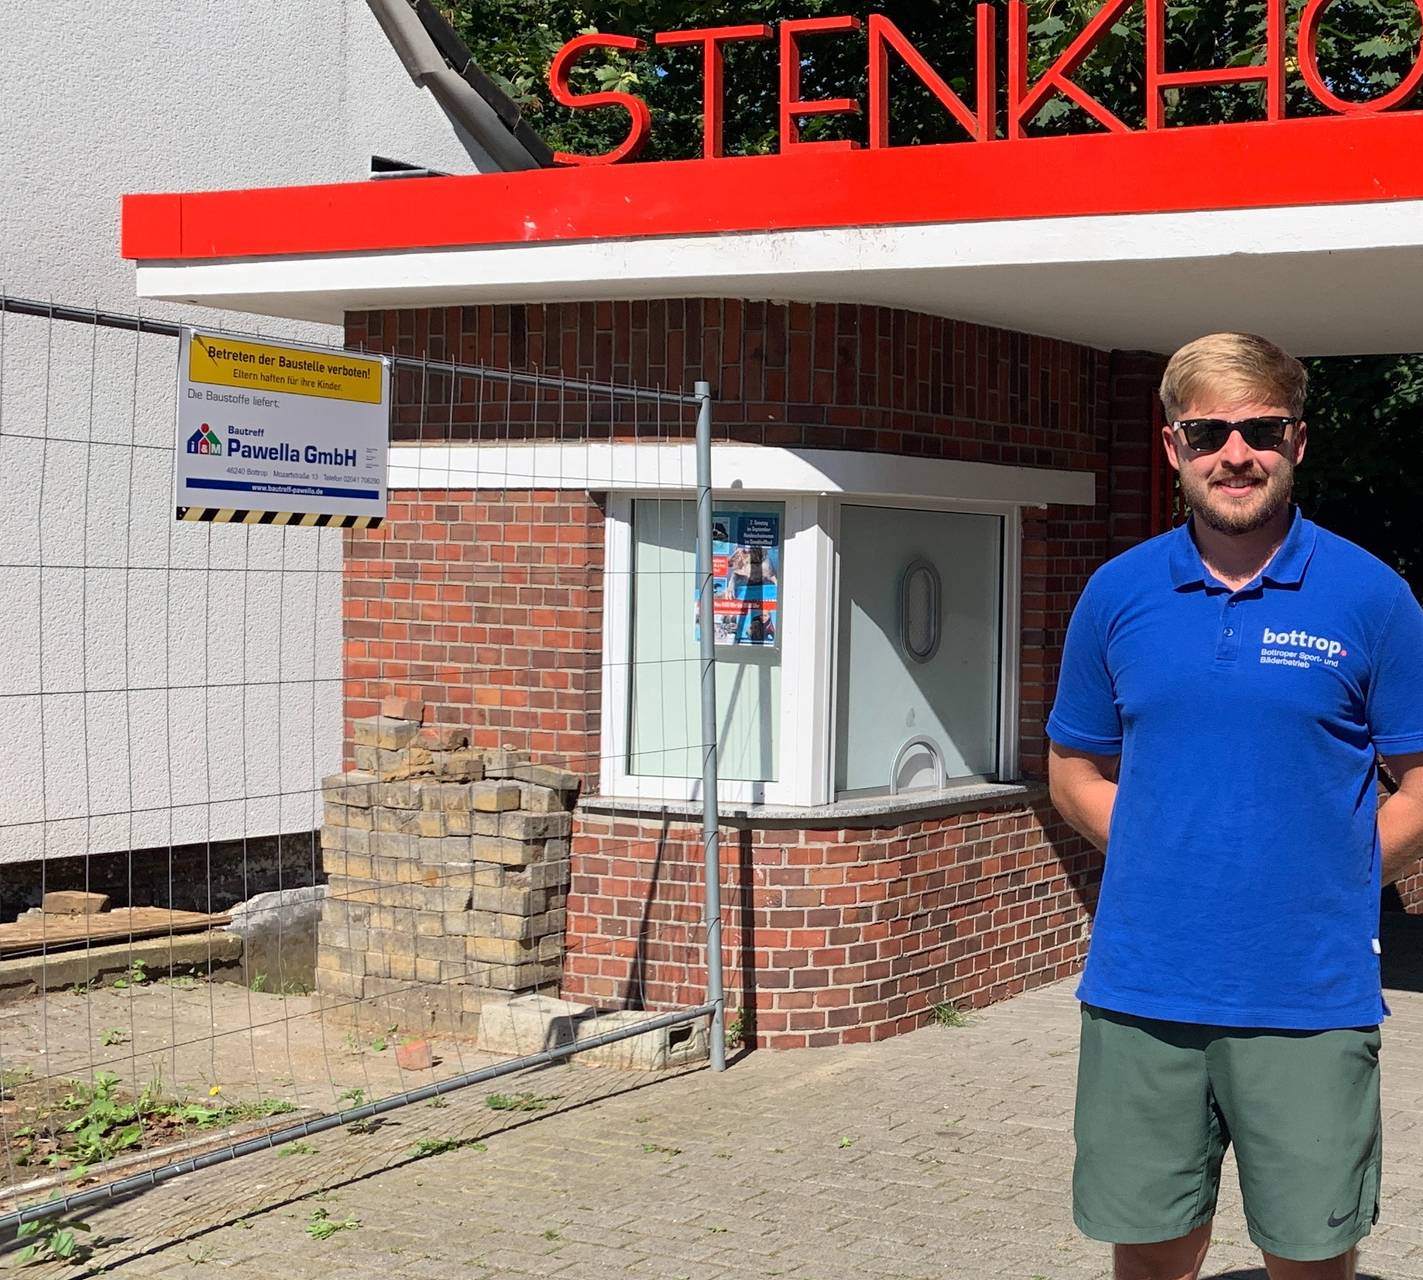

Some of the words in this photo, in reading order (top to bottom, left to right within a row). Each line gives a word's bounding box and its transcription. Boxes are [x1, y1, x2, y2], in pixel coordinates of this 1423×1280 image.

[208, 346, 255, 363] Betreten
[258, 353, 275, 366] der
[279, 356, 325, 373] Baustelle
[327, 364, 371, 379] verboten!
[233, 368, 258, 380] Eltern
[260, 372, 285, 384] haften
[287, 375, 298, 386] für
[317, 380, 343, 391] Kinder.
[188, 388, 202, 400] Die
[206, 390, 249, 405] Baustoffe
[228, 425, 264, 437] Bautreff
[227, 438, 300, 463] Pawella
[304, 445, 357, 467] GmbH
[251, 484, 324, 495] www.bautreff-pawella.de
[1263, 627, 1348, 658] bottrop.
[1260, 648, 1298, 659] Bottroper
[1323, 658, 1339, 668] und
